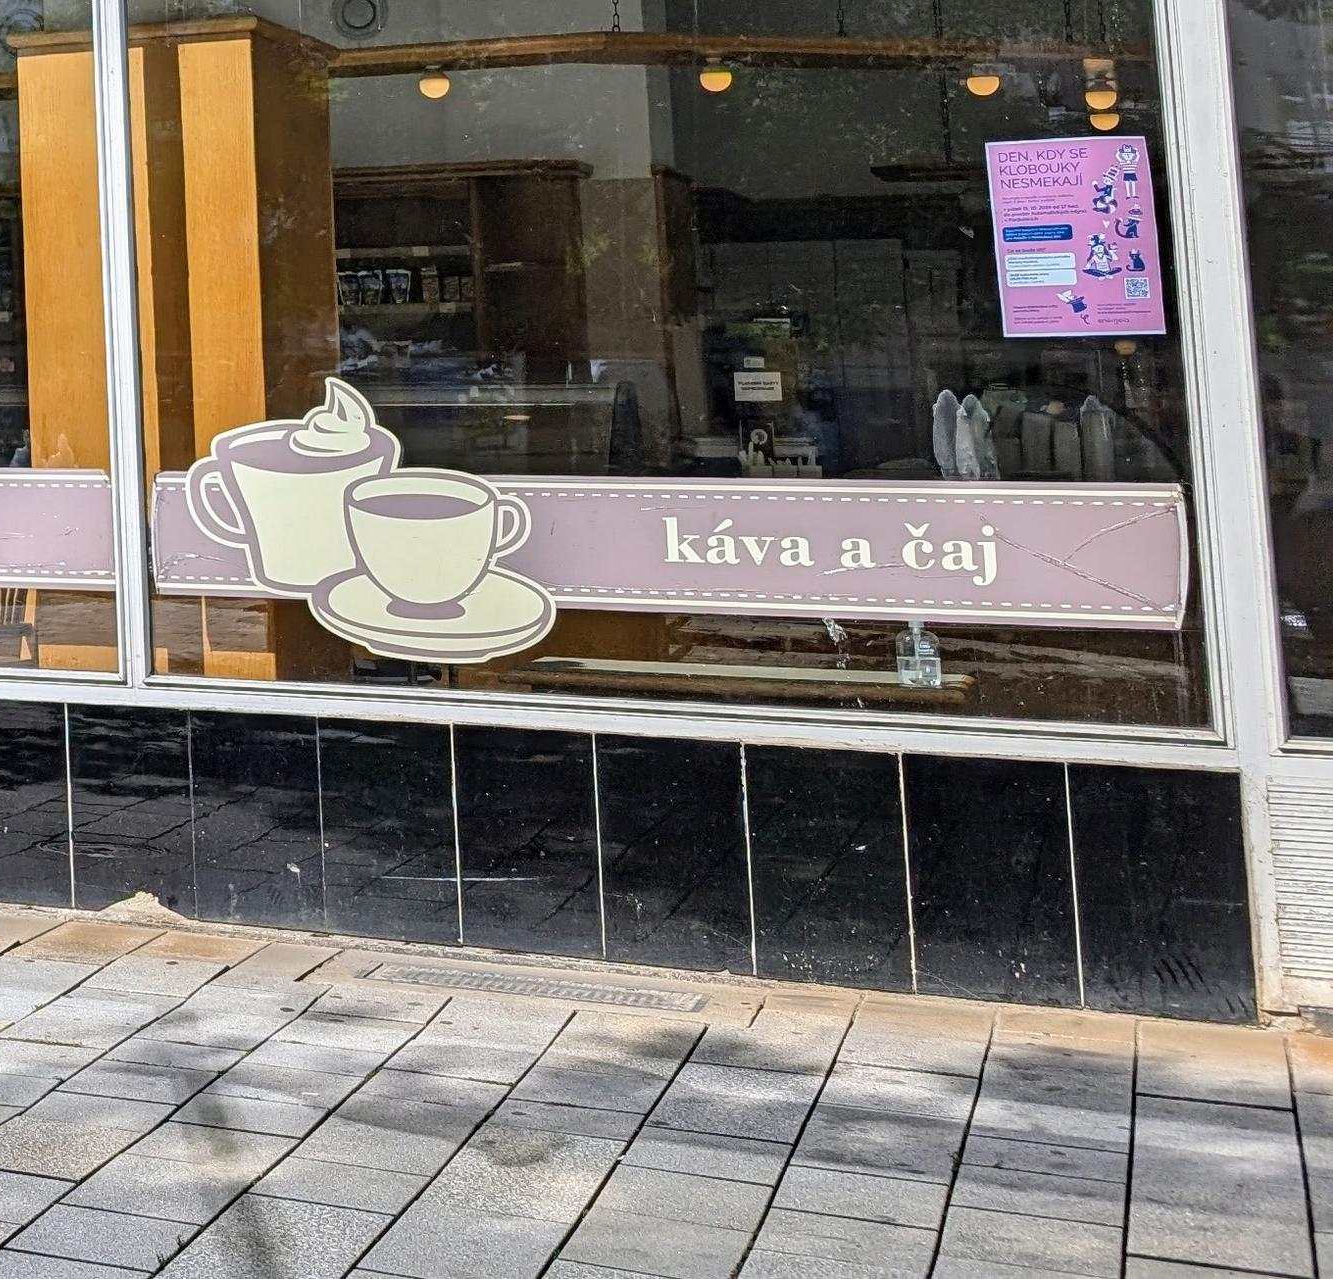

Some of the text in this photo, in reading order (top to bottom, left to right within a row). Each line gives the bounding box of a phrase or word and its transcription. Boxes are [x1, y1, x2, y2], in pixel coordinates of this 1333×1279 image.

[998, 148, 1088, 163] DEN, KDY SE
[999, 162, 1080, 176] KLOBOUKY
[1000, 173, 1082, 189] NESMEKAJÍ
[662, 517, 998, 586] káva a čaj
